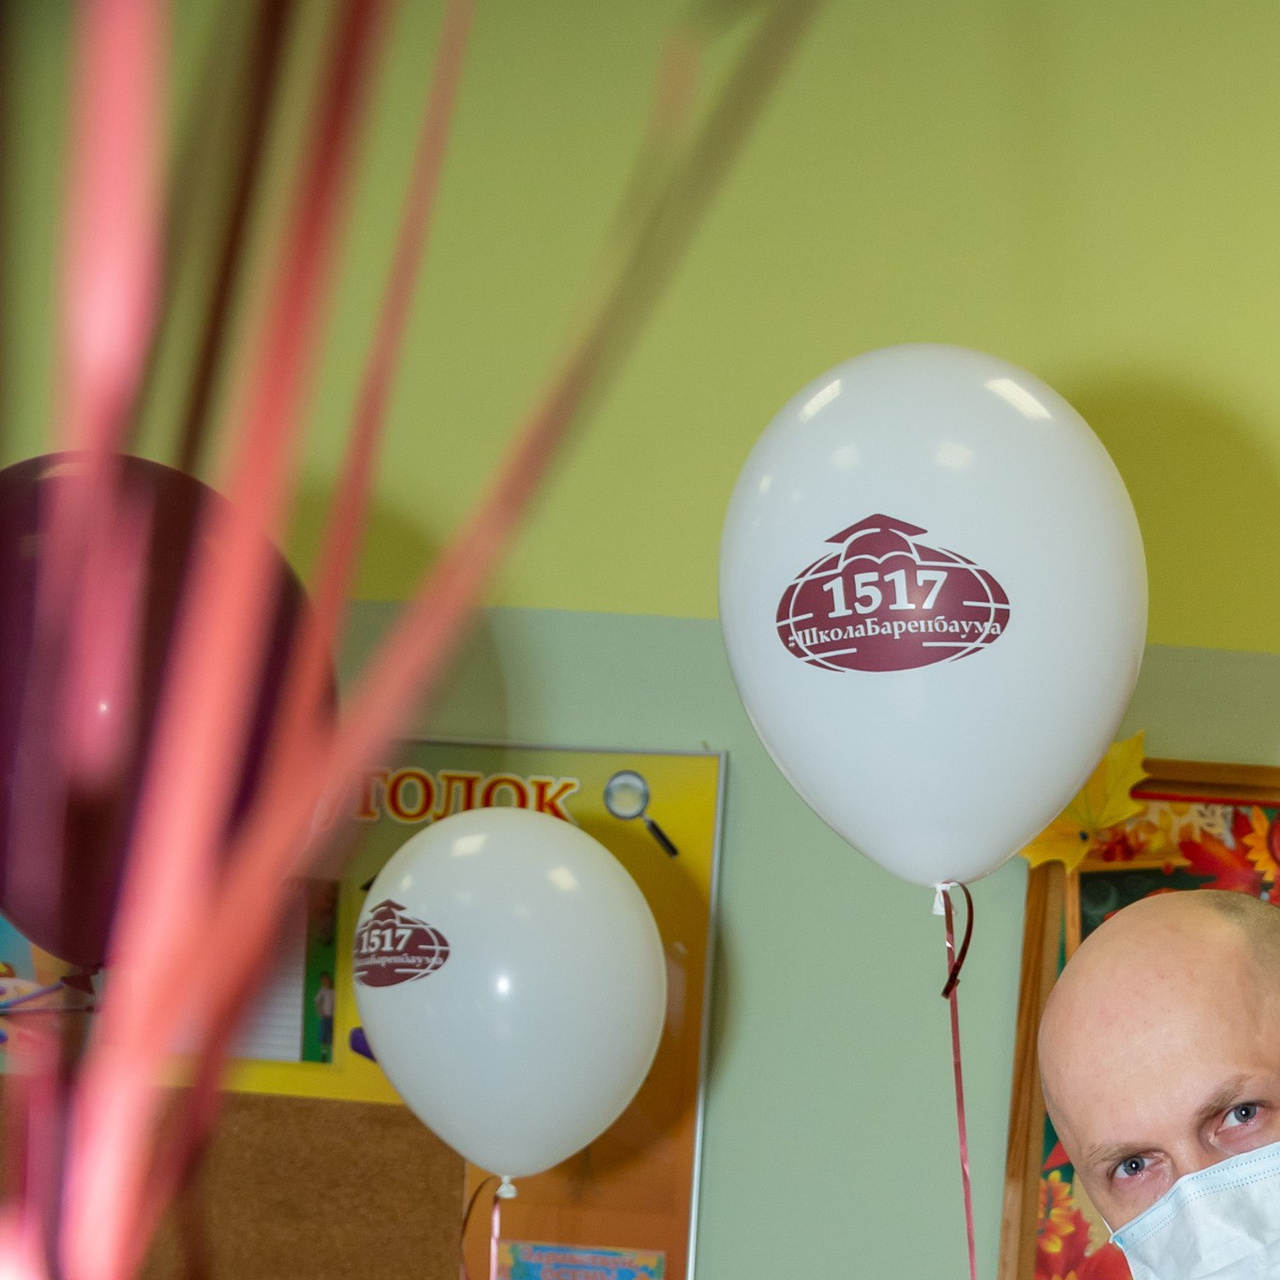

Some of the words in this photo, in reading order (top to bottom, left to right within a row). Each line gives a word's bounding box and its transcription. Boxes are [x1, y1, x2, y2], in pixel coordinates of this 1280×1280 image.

[822, 569, 948, 618] 1517
[788, 615, 1001, 647] #ШколаБаренбаума
[354, 770, 579, 822] ГОЛОК
[360, 928, 413, 953] 1517
